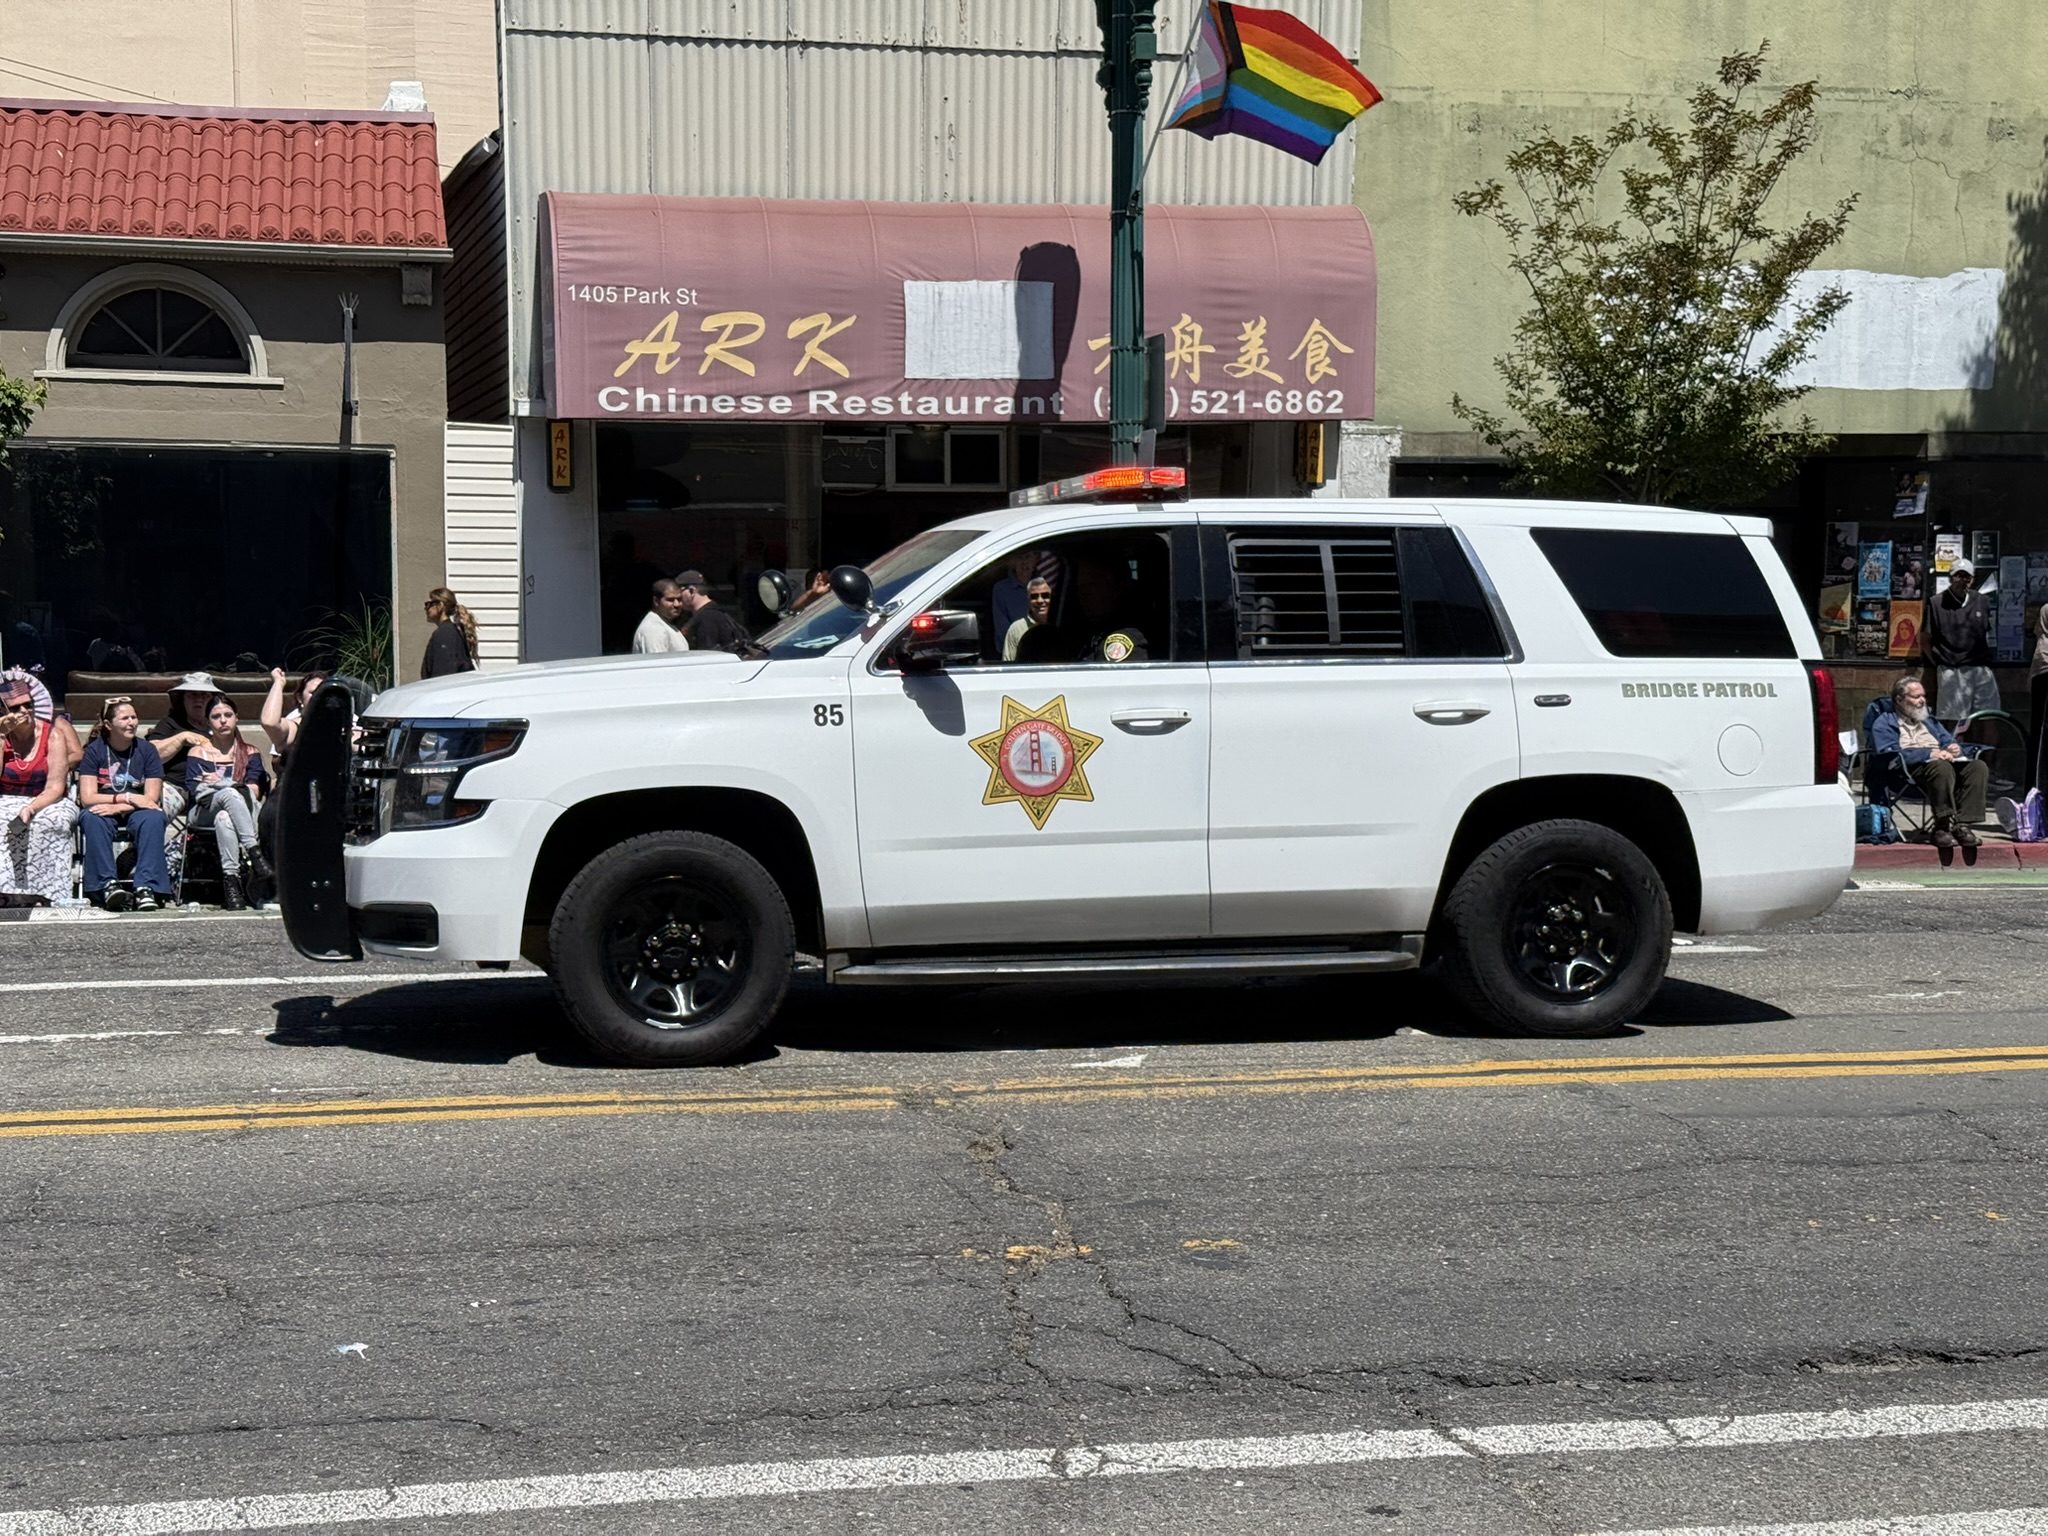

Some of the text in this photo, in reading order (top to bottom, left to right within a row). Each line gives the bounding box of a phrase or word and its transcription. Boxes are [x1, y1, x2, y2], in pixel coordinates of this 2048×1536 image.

[568, 284, 698, 306] 1405 Park St
[613, 310, 858, 379] ARK
[598, 386, 794, 414] Chinese
[808, 389, 1065, 416] Restaurant
[1189, 389, 1344, 415] 521-6862
[554, 429, 568, 480] ARK
[1621, 682, 1778, 698] BRIDGE PATROL
[813, 703, 844, 727] 85
[1004, 724, 1027, 750] GOLDEN
[1027, 723, 1045, 731] GATE
